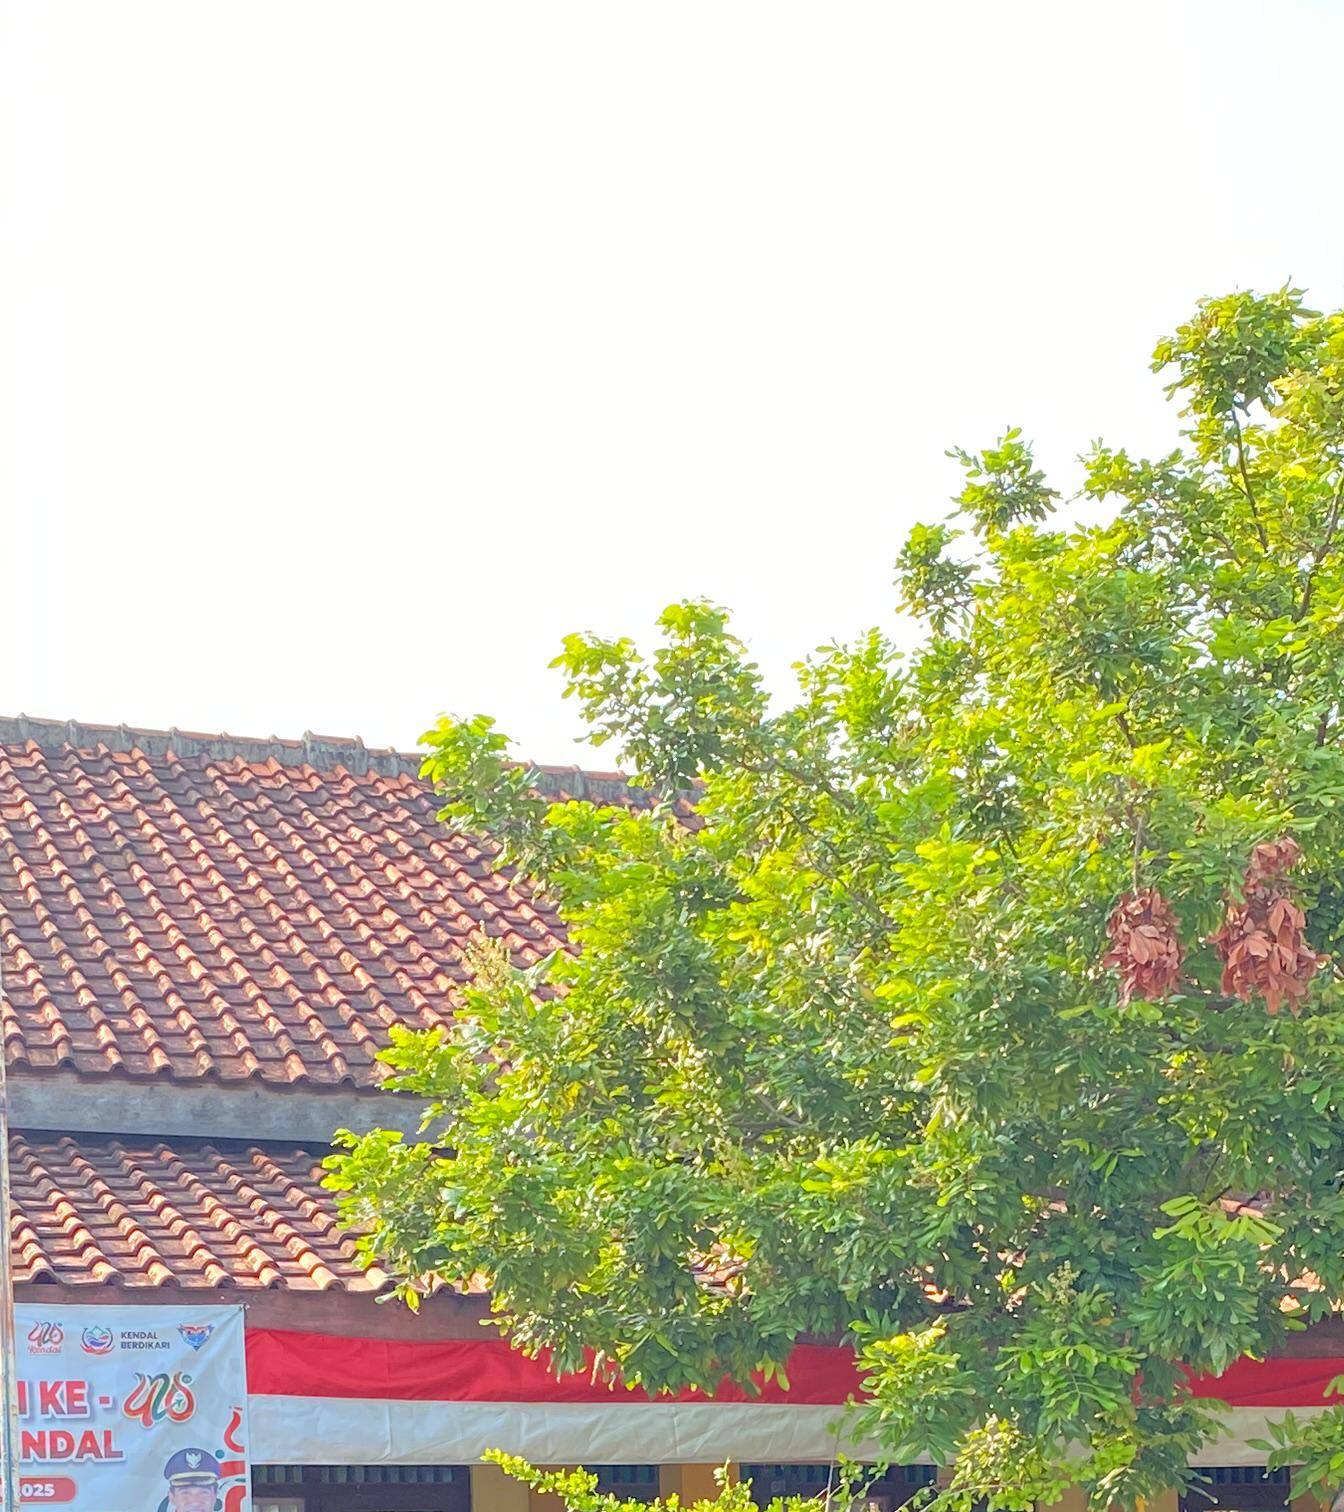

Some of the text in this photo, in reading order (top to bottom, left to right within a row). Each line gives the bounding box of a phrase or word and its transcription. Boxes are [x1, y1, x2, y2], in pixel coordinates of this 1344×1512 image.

[120, 1331, 158, 1340] KENDAL
[120, 1341, 171, 1350] BERDIKARI
[40, 1380, 87, 1415] KE
[17, 1483, 55, 1497] 025
